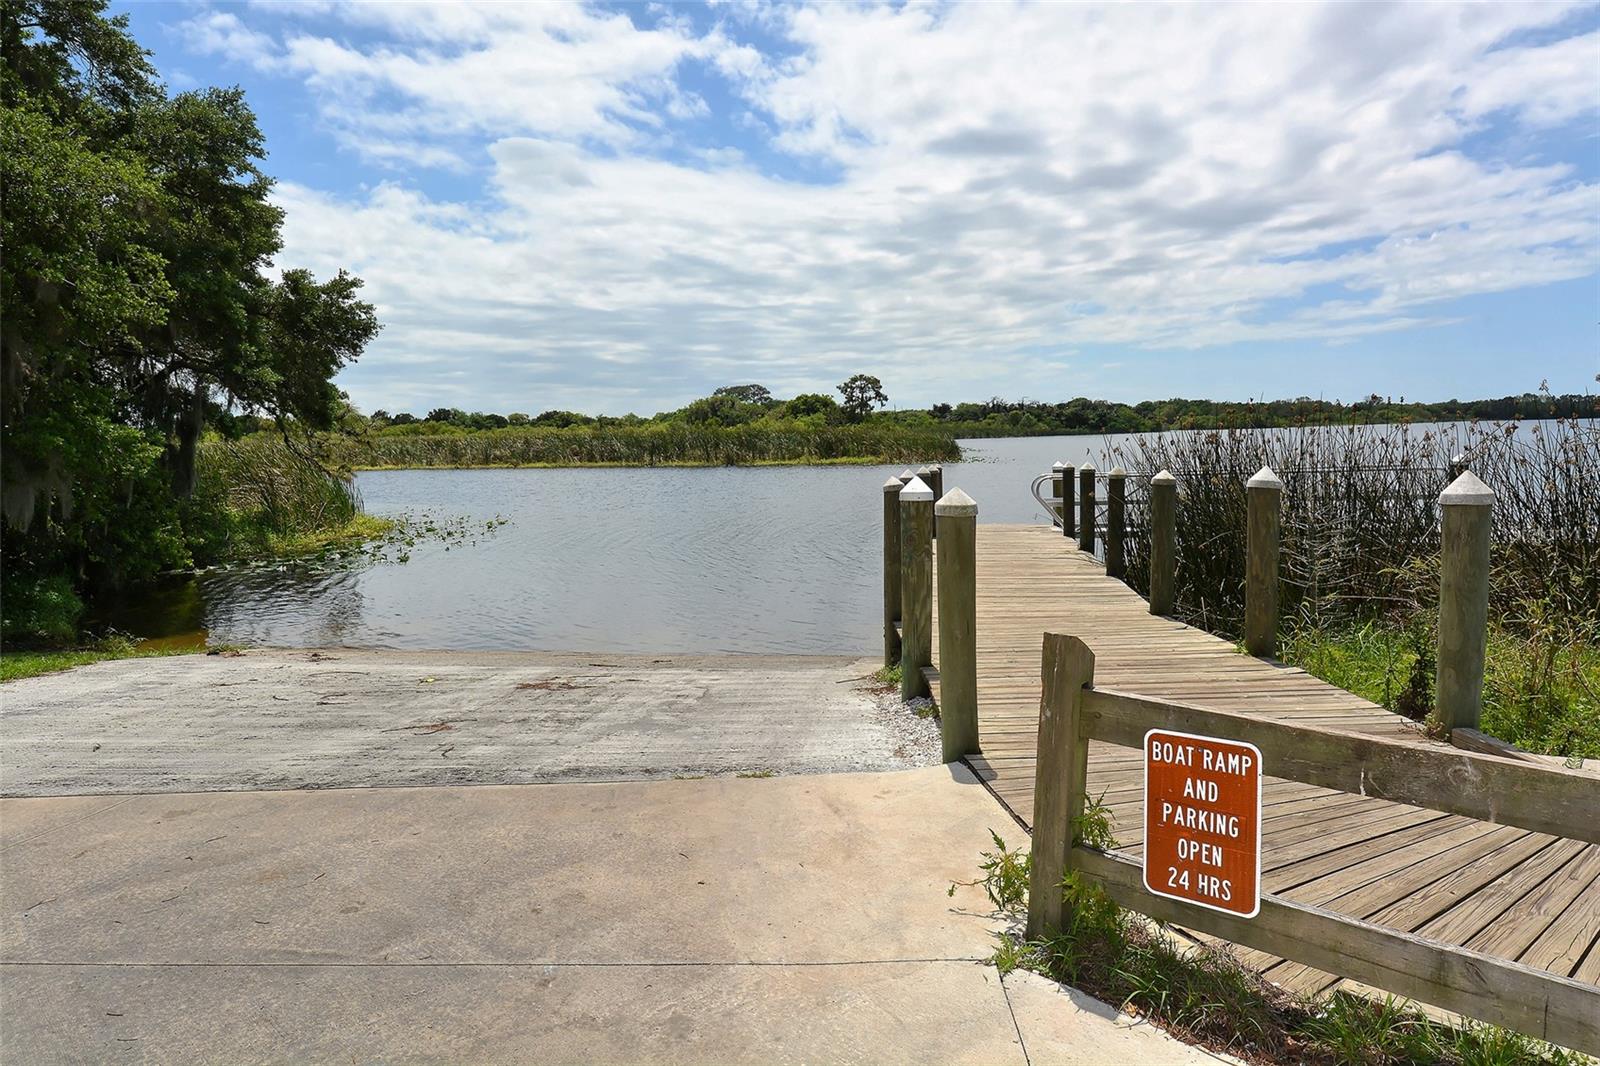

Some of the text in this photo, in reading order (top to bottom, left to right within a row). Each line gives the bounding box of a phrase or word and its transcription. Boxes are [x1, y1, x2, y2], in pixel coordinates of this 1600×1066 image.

[1152, 740, 1252, 777] BOAT RAMP
[1183, 777, 1219, 803] AND
[1162, 802, 1239, 838] PARKING
[1177, 838, 1222, 868] OPEN
[1167, 866, 1232, 901] 24 HRS
